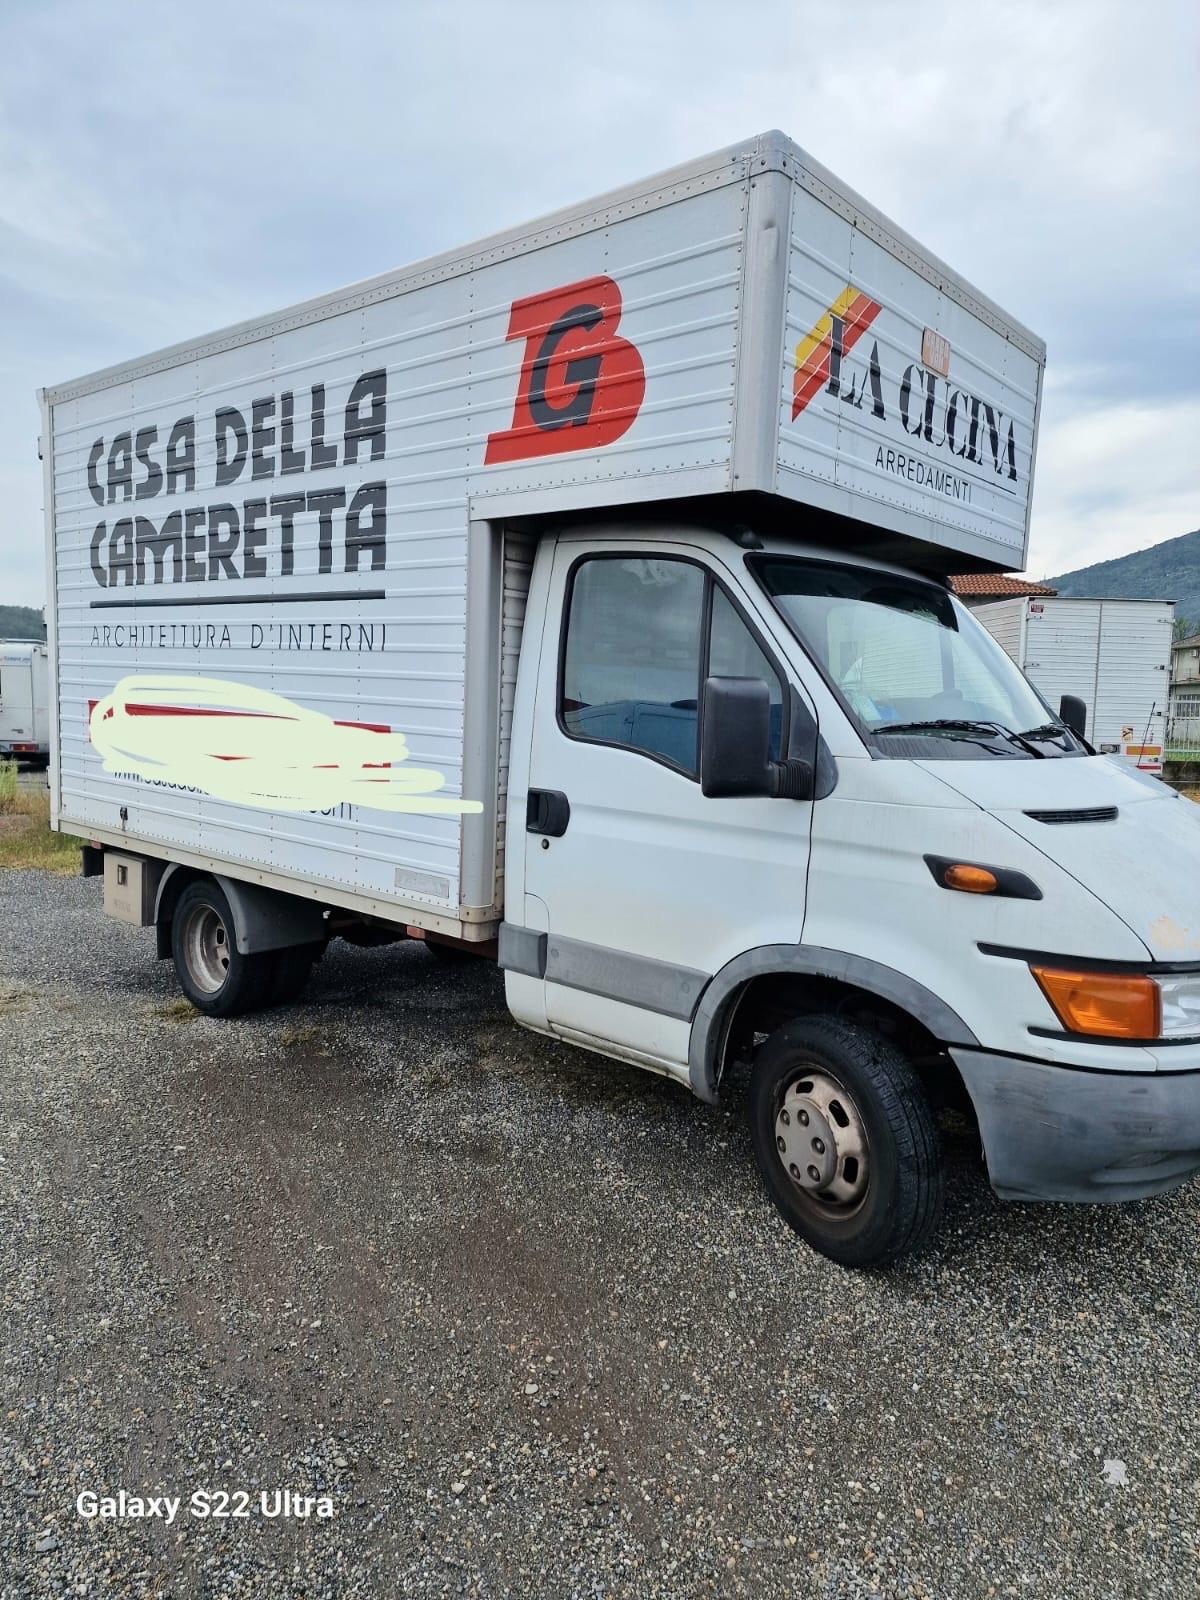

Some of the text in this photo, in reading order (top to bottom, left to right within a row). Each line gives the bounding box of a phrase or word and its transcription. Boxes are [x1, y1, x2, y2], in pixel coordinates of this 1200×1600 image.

[87, 367, 387, 507] CASA DELLA
[825, 313, 1018, 483] LA CUCINA
[875, 445, 972, 504] ARREDAMENTI
[89, 480, 387, 588] CAMERETTA
[90, 623, 387, 651] ARCHITETTURA D'INTERNI
